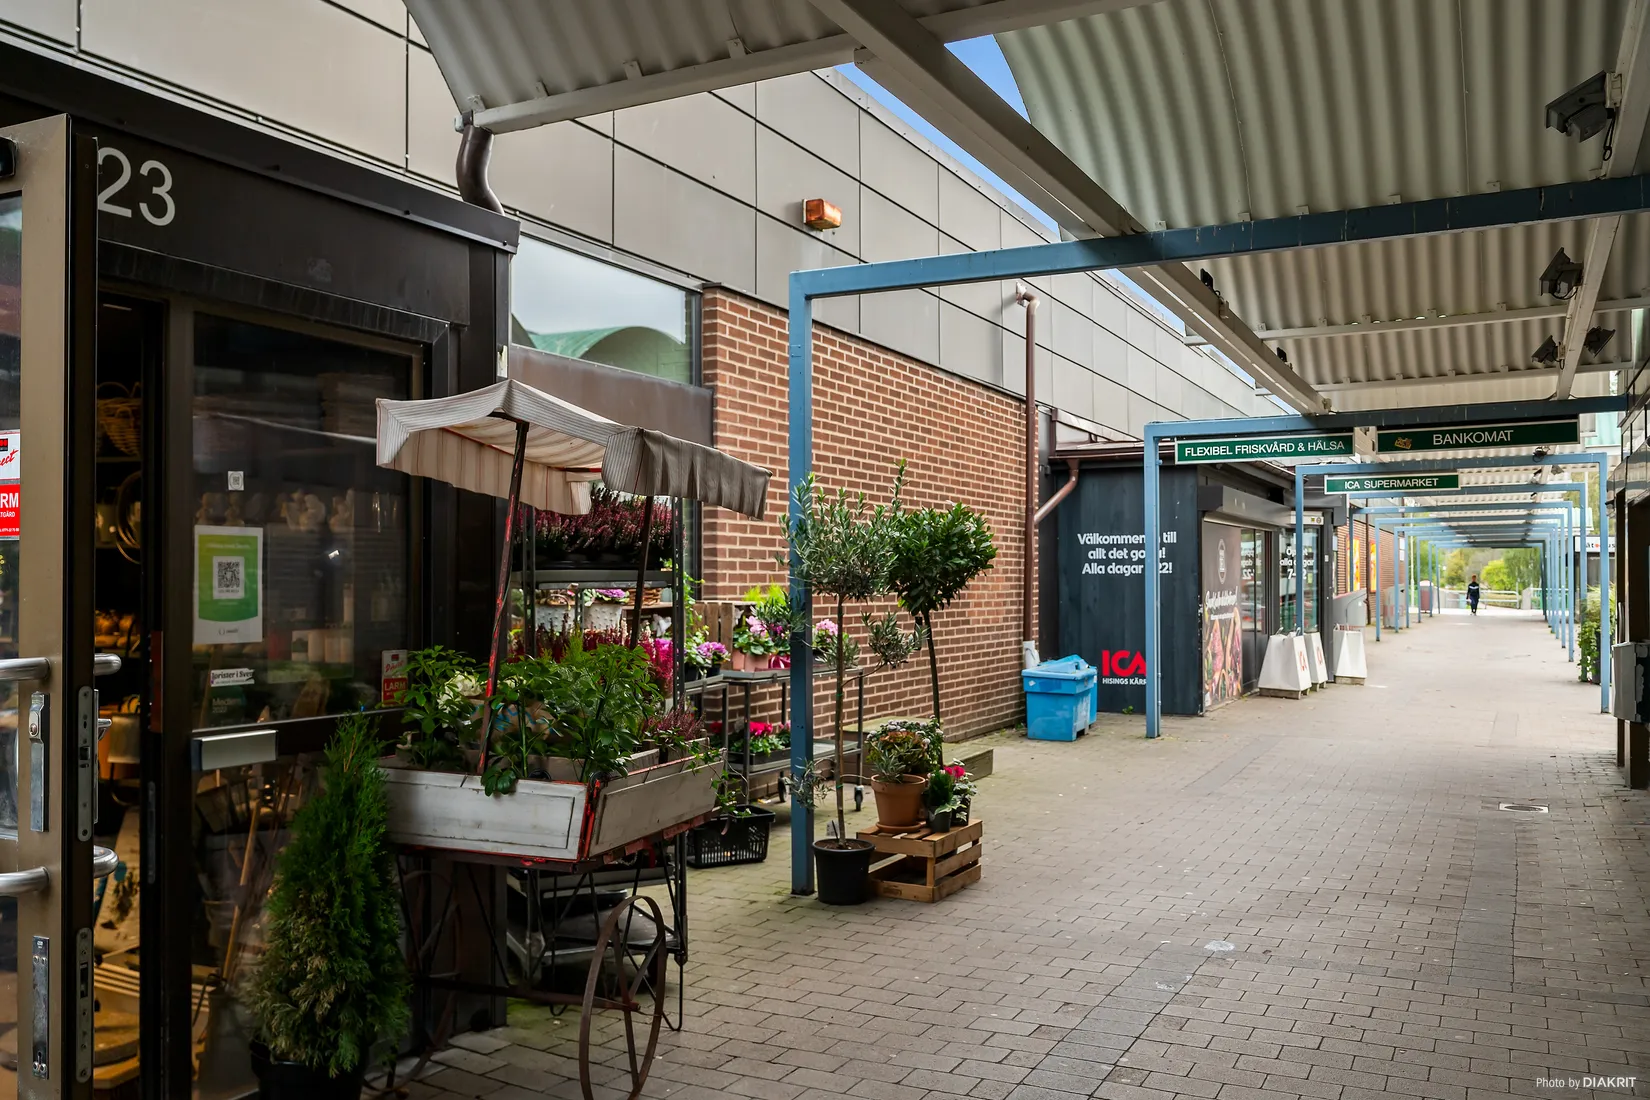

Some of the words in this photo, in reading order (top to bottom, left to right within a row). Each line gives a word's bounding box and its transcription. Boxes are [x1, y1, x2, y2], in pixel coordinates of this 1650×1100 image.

[97, 147, 175, 226] 23
[1433, 430, 1514, 445] BANKOMAT
[1185, 445, 1232, 457] FLEXIBEL
[1235, 441, 1295, 455] FRISKVÅRD
[1298, 443, 1305, 452] &
[1307, 440, 1345, 451] HÄLSA
[1344, 480, 1360, 490] ICA
[1364, 478, 1439, 489] SUPERMARKET
[0, 492, 19, 509] RM
[1077, 533, 1146, 545] Välkommen
[1162, 531, 1177, 544] till
[1088, 547, 1107, 560] allt
[1108, 547, 1128, 560] det
[1130, 547, 1166, 561] go!
[1082, 562, 1105, 575] Alla
[1107, 562, 1144, 576] dagar
[1279, 558, 1293, 566] alla
[1102, 650, 1147, 677] ICA
[385, 682, 406, 691] LARM
